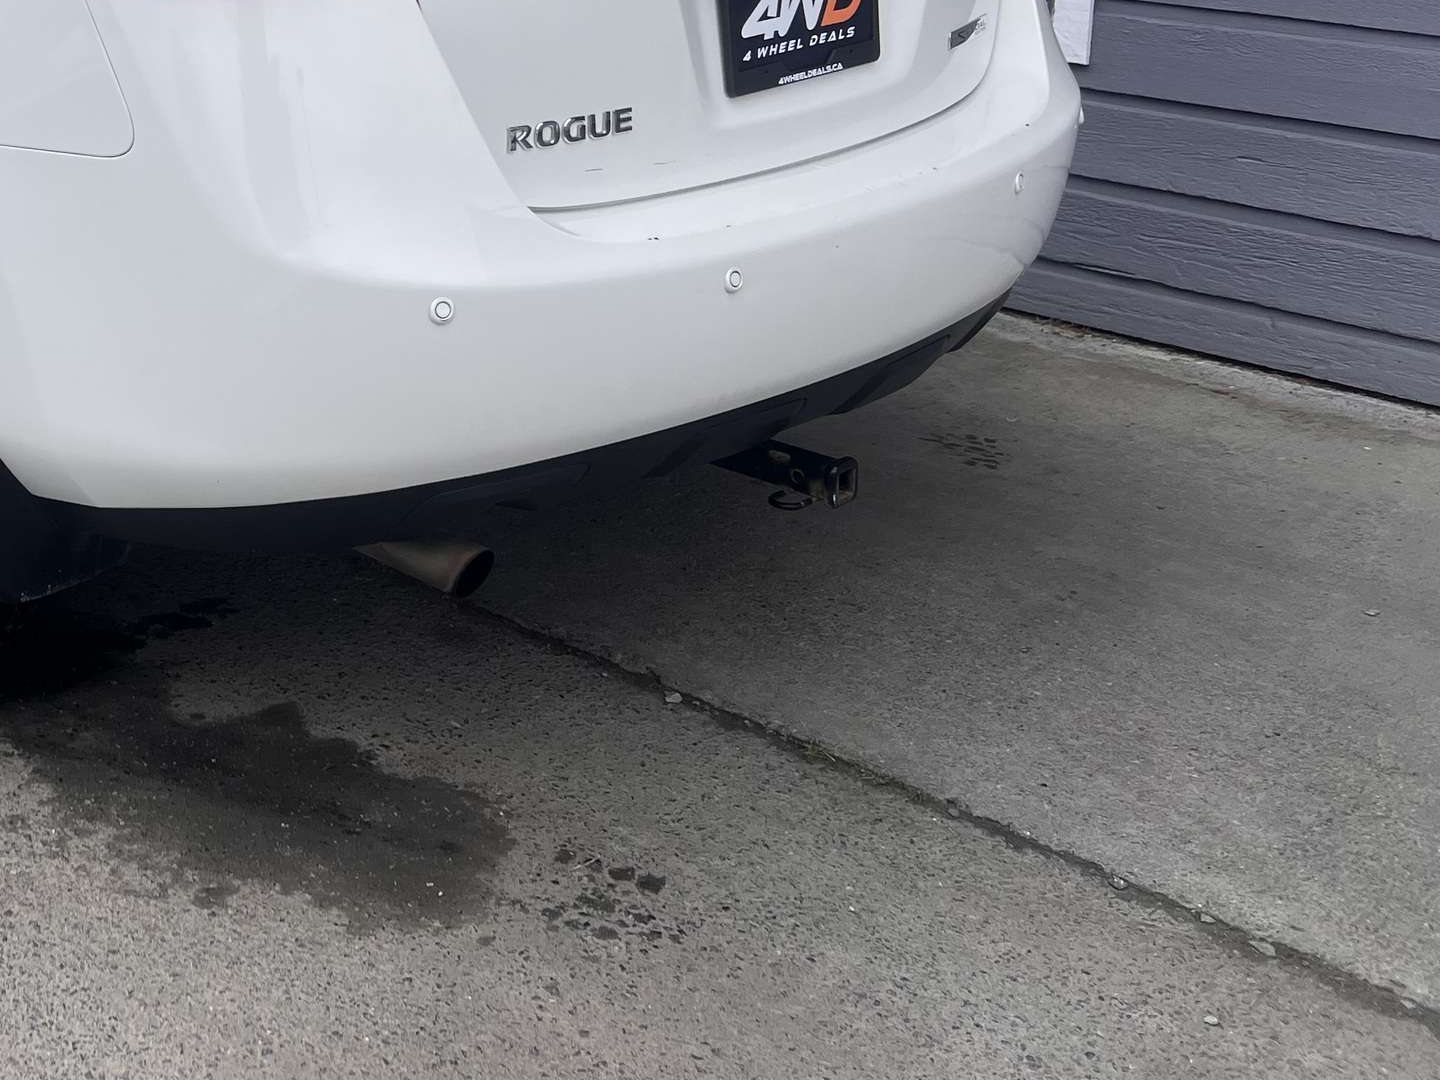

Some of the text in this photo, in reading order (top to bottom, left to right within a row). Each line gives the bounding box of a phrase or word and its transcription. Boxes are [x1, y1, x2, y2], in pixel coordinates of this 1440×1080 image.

[742, 26, 856, 62] 4 WHEEL DEALS
[778, 62, 844, 85] 4WHEELDEALS.CA
[506, 106, 633, 153] ROGUE
